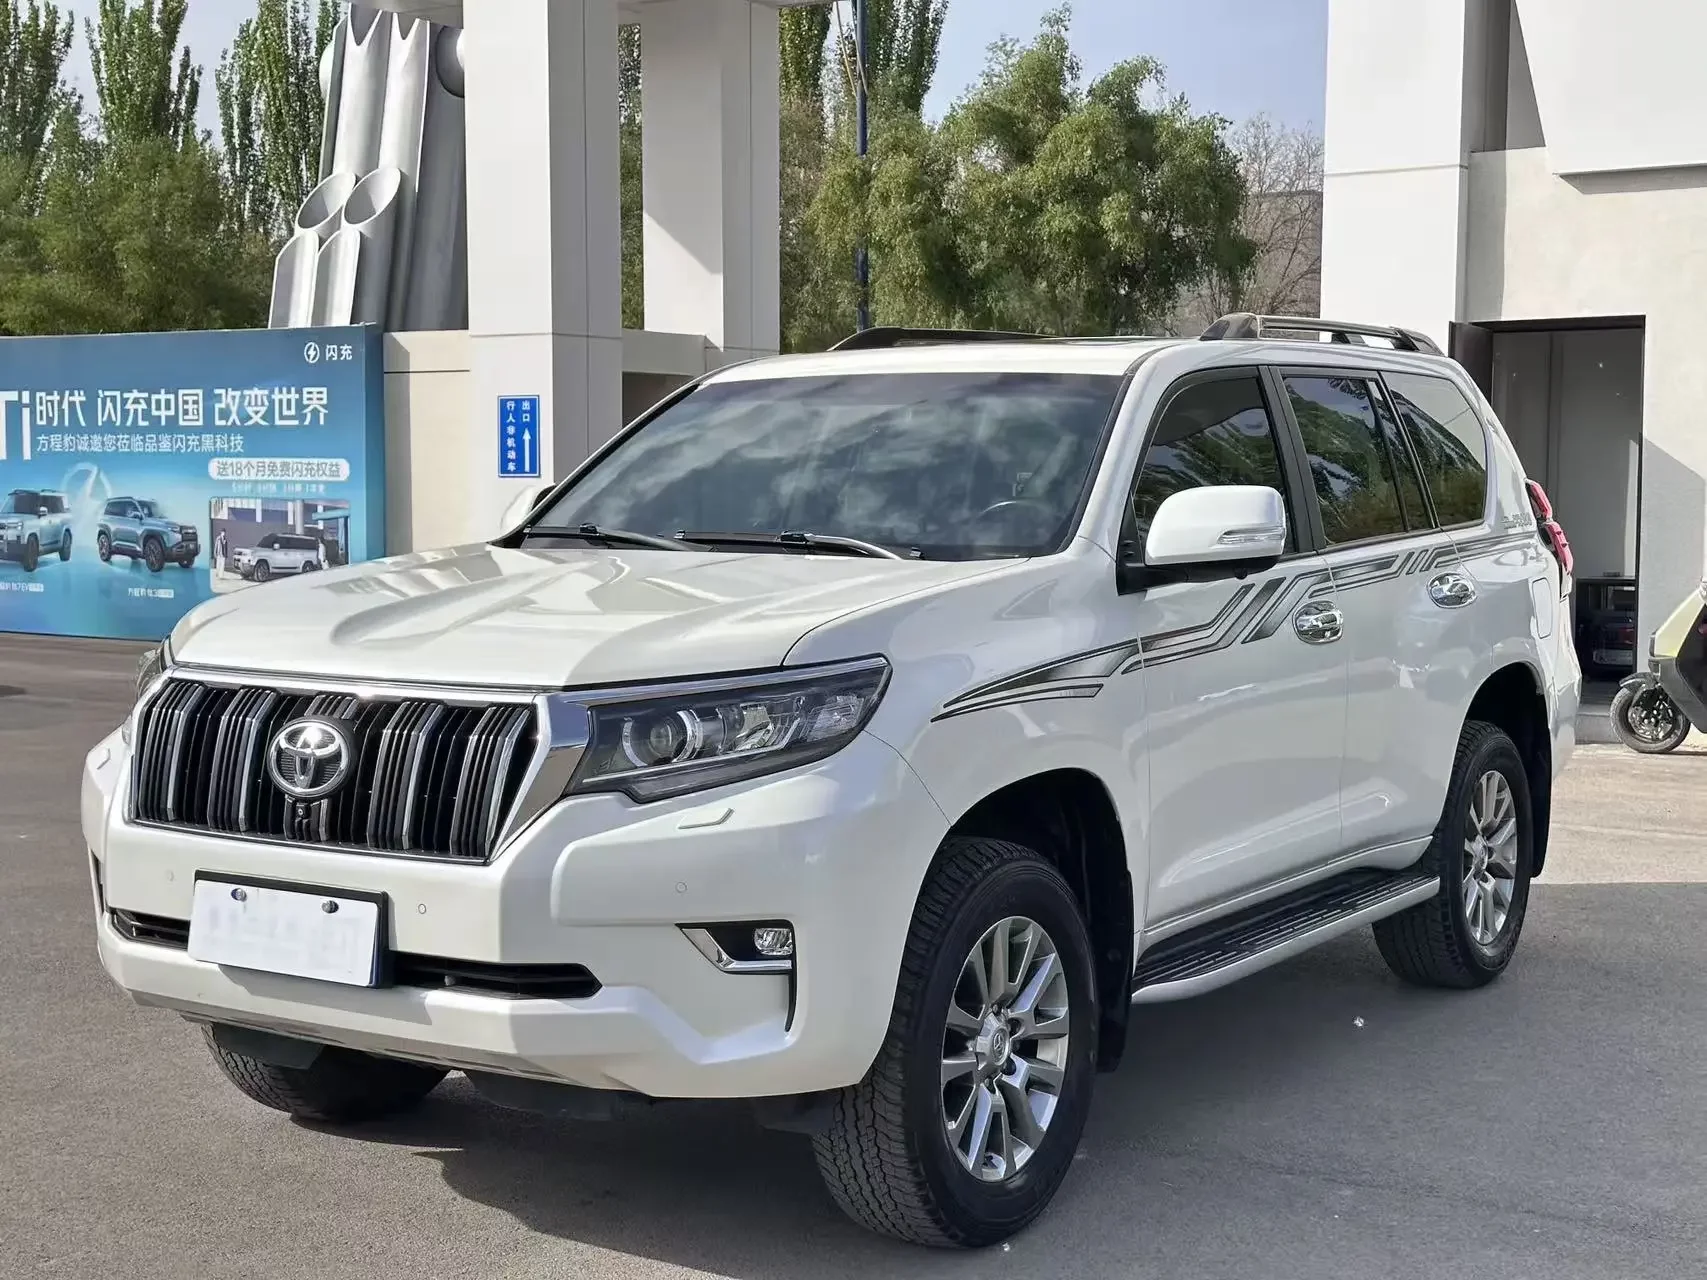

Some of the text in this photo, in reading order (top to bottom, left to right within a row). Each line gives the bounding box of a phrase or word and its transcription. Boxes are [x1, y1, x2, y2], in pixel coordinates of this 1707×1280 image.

[325, 344, 353, 361] 闪充
[35, 389, 87, 427] 时代
[97, 388, 204, 427] 闪充中国
[213, 386, 329, 426] 改变世界
[522, 400, 531, 422] 出口
[36, 433, 244, 453] 方程豹诚邀您莅临品鉴闪充黑科技
[216, 460, 341, 478] 送18个月免费闪充权益
